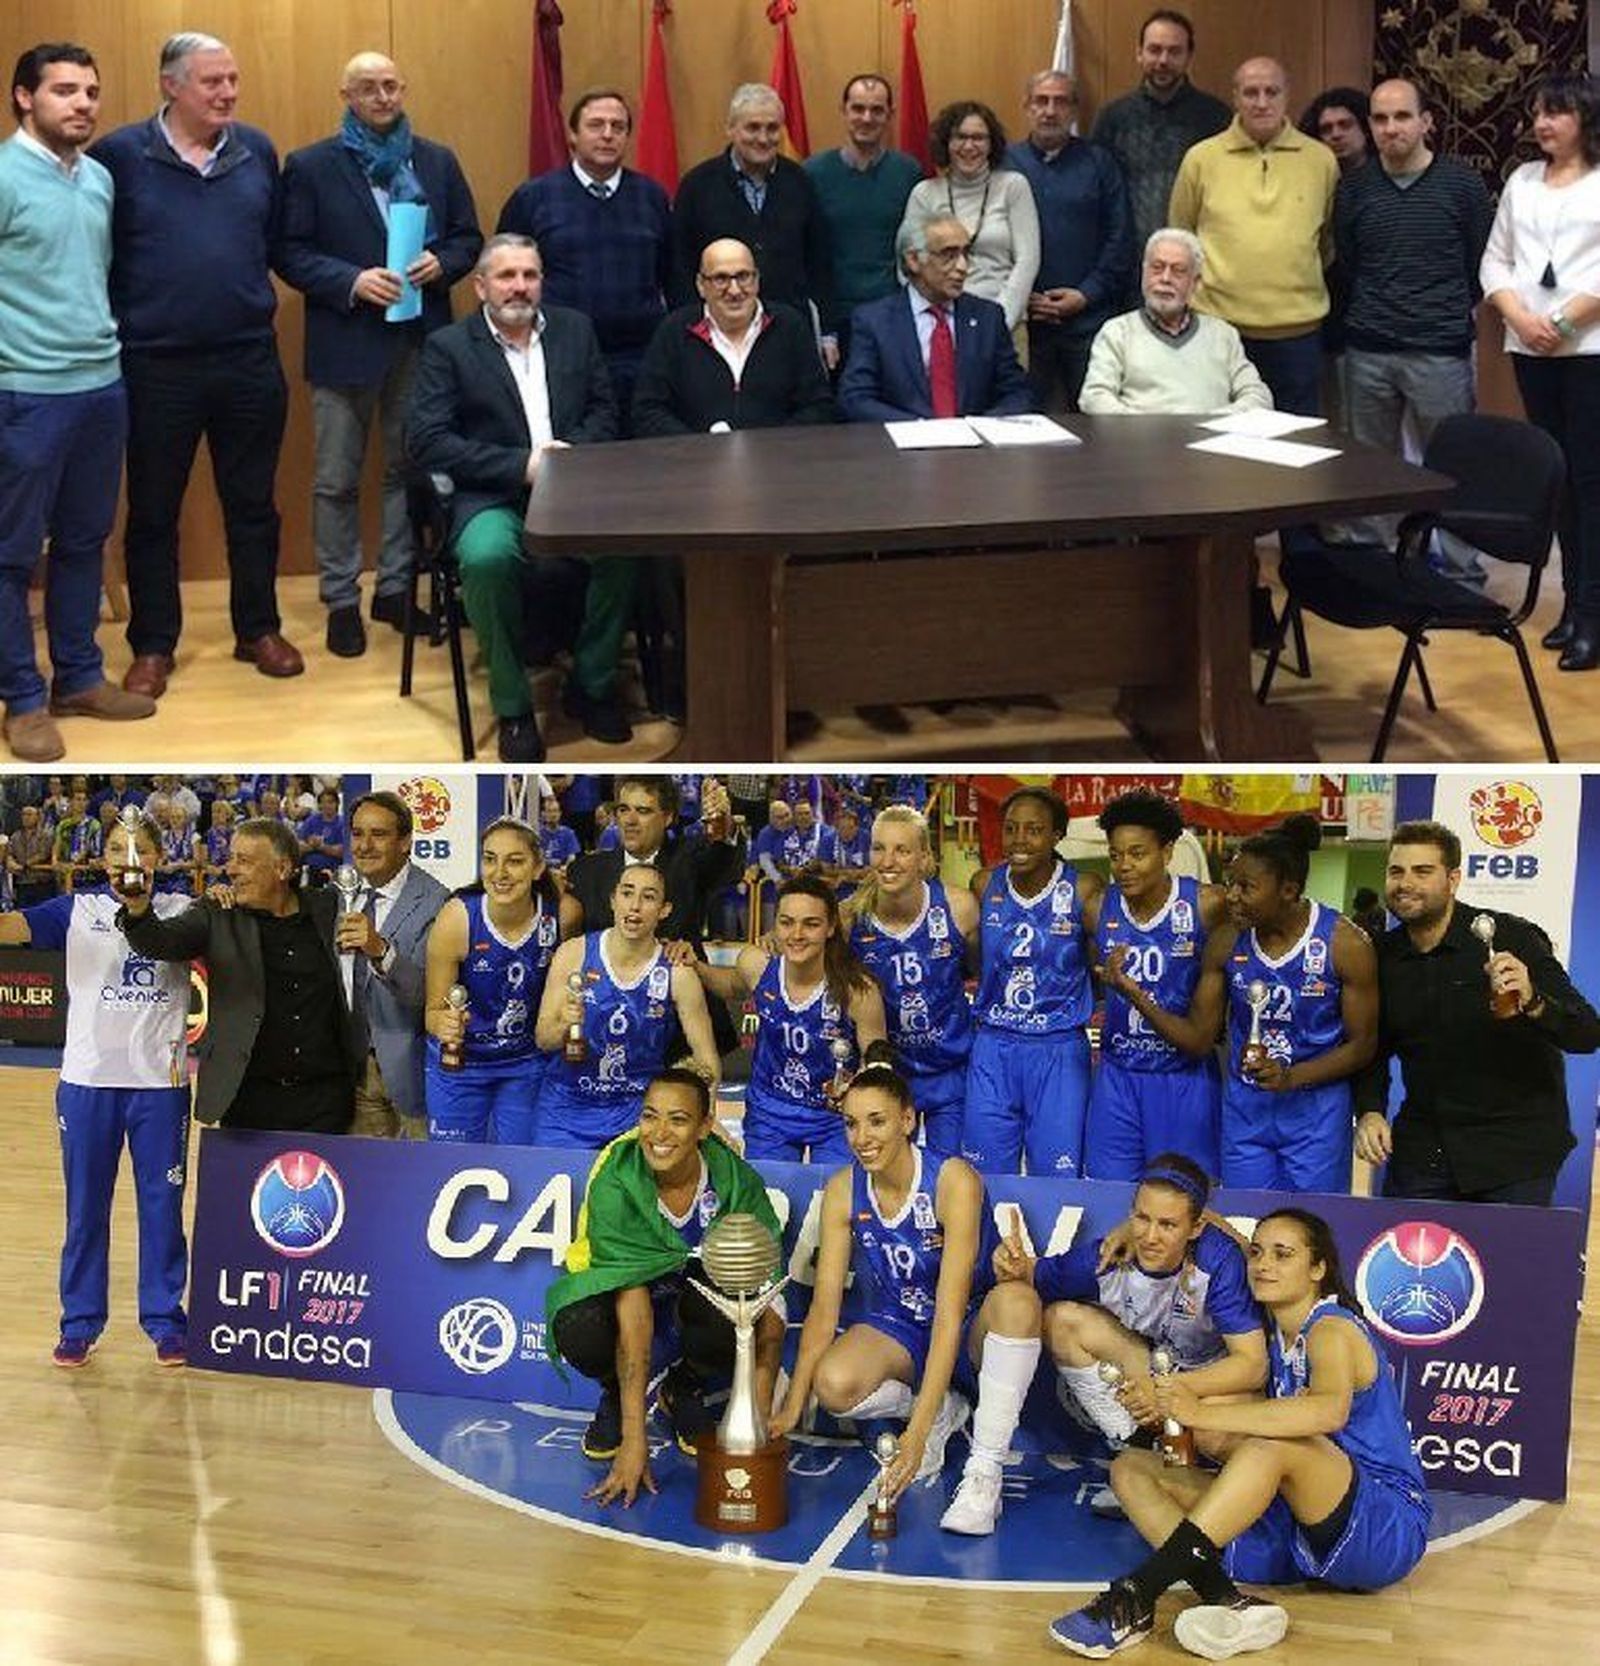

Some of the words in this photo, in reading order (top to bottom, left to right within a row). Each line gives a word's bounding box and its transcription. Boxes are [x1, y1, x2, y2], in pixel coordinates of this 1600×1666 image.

[414, 839, 451, 859] eB
[1012, 923, 1034, 957] 2
[507, 962, 526, 991] 9
[891, 952, 923, 986] 15
[1125, 945, 1164, 983] 20
[608, 1003, 629, 1035] 6
[1260, 985, 1292, 1021] 2
[782, 1021, 809, 1055] 10
[881, 1243, 916, 1279] 19
[218, 1269, 281, 1310] LF1
[298, 1270, 371, 1296] FINAL
[302, 1298, 364, 1325] 2017
[211, 1321, 371, 1368] endesa
[1420, 1361, 1520, 1393] FINAL
[1427, 1394, 1513, 1427] 2017
[1411, 1431, 1522, 1477] esa
